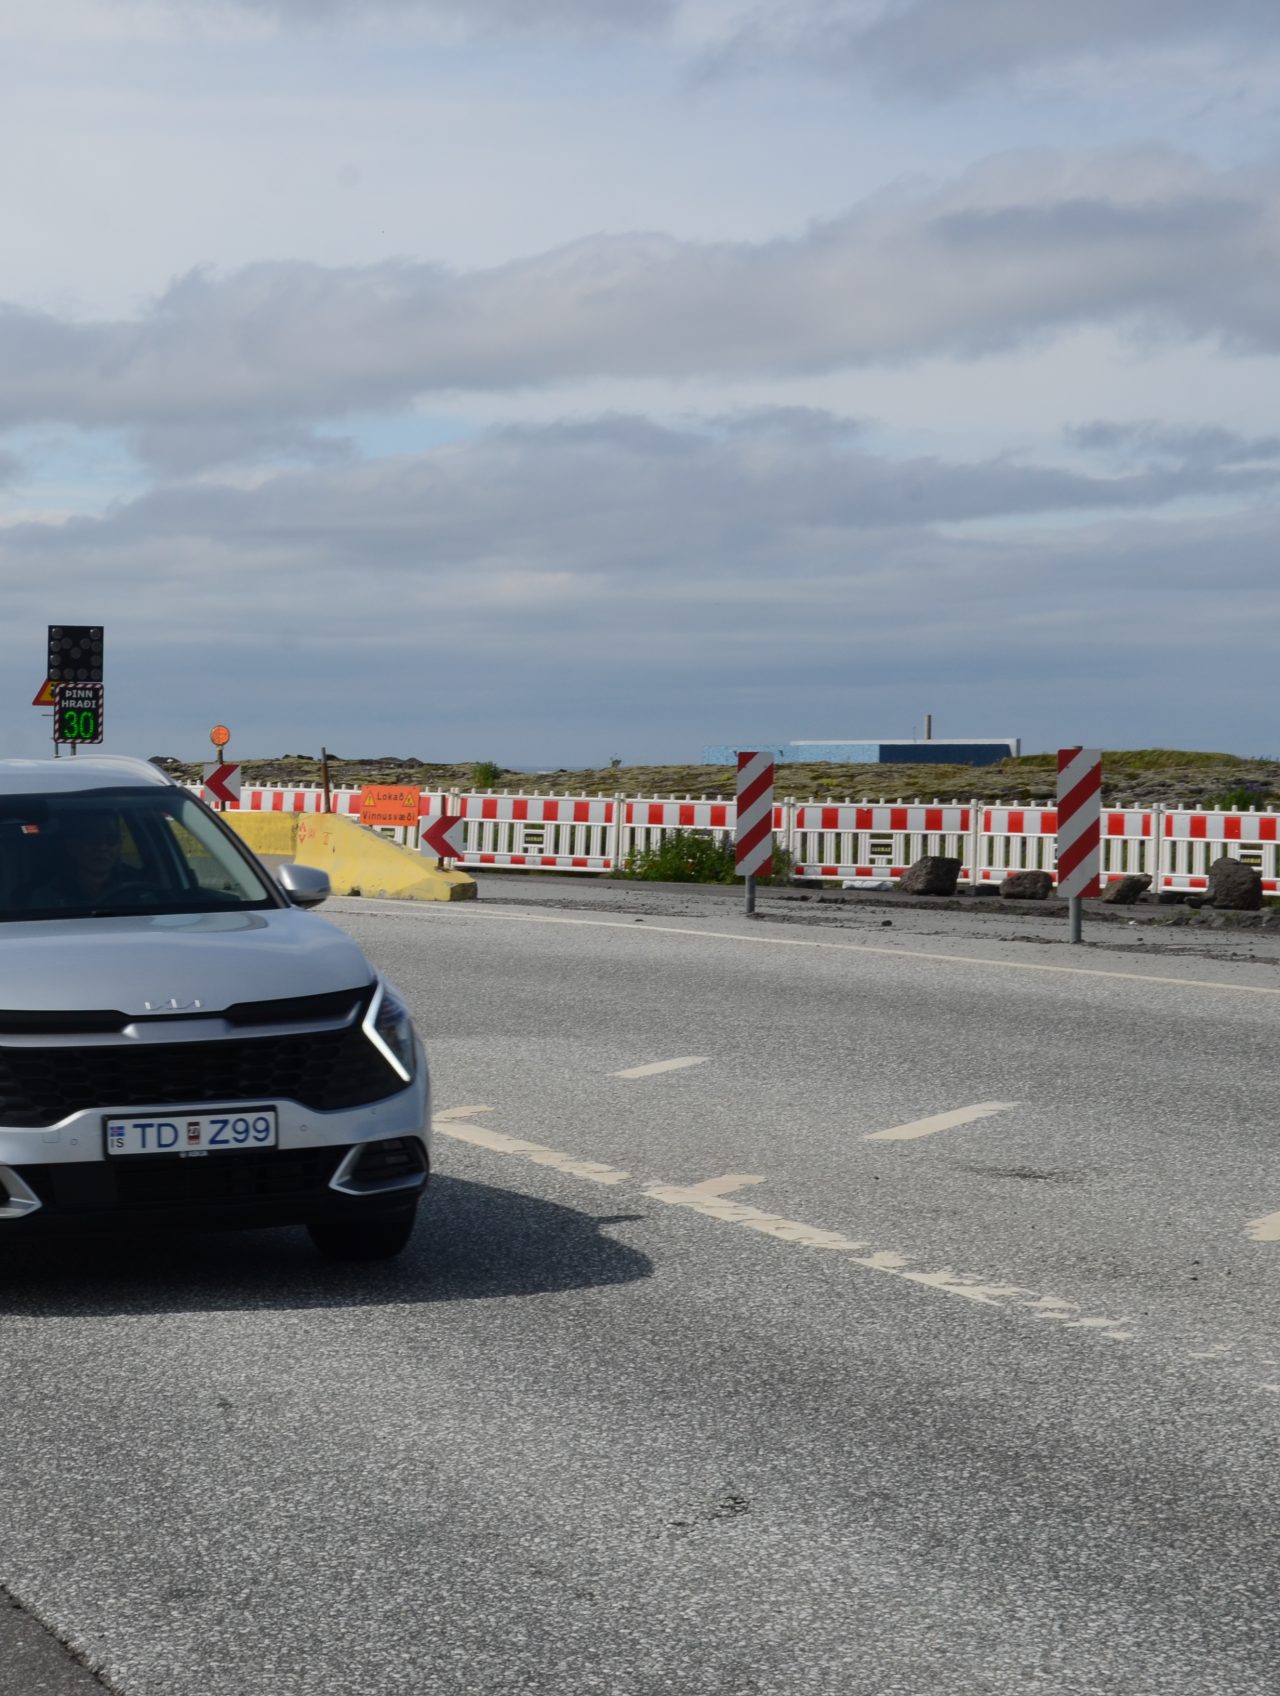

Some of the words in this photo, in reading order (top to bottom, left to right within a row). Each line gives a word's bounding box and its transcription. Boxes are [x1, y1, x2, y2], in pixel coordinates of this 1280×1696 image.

[64, 711, 94, 738] 30
[132, 1122, 179, 1149] TD
[208, 1116, 270, 1145] Z99
